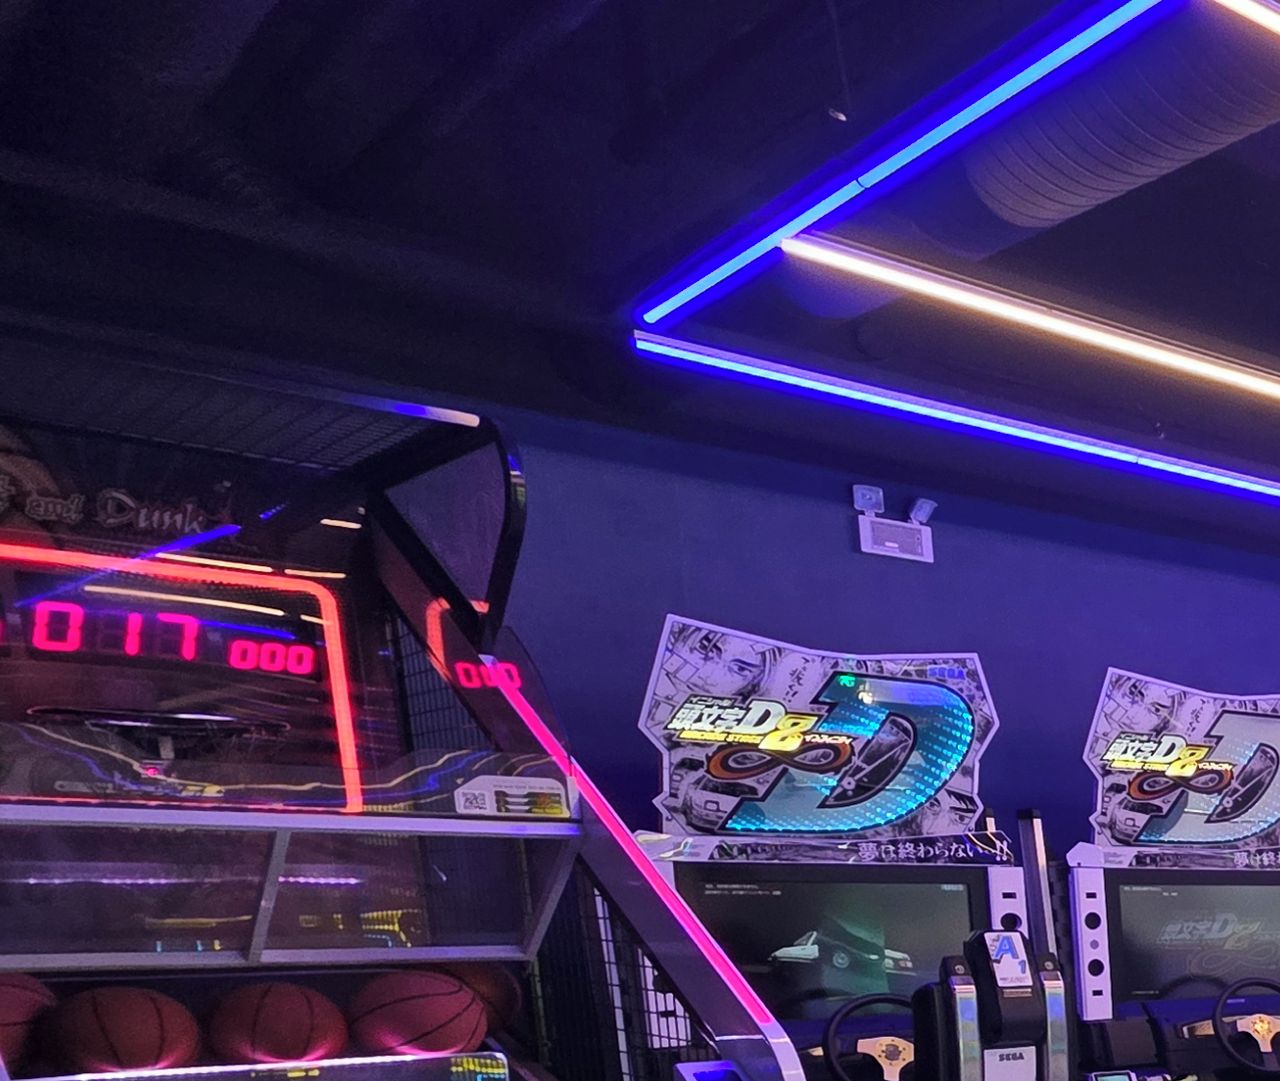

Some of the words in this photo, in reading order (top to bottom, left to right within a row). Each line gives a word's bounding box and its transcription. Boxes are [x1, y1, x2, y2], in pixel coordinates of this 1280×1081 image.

[98, 488, 208, 534] Dunk
[228, 639, 315, 675] 000
[927, 666, 967, 681] SEGA
[998, 1052, 1025, 1062] SEGA
